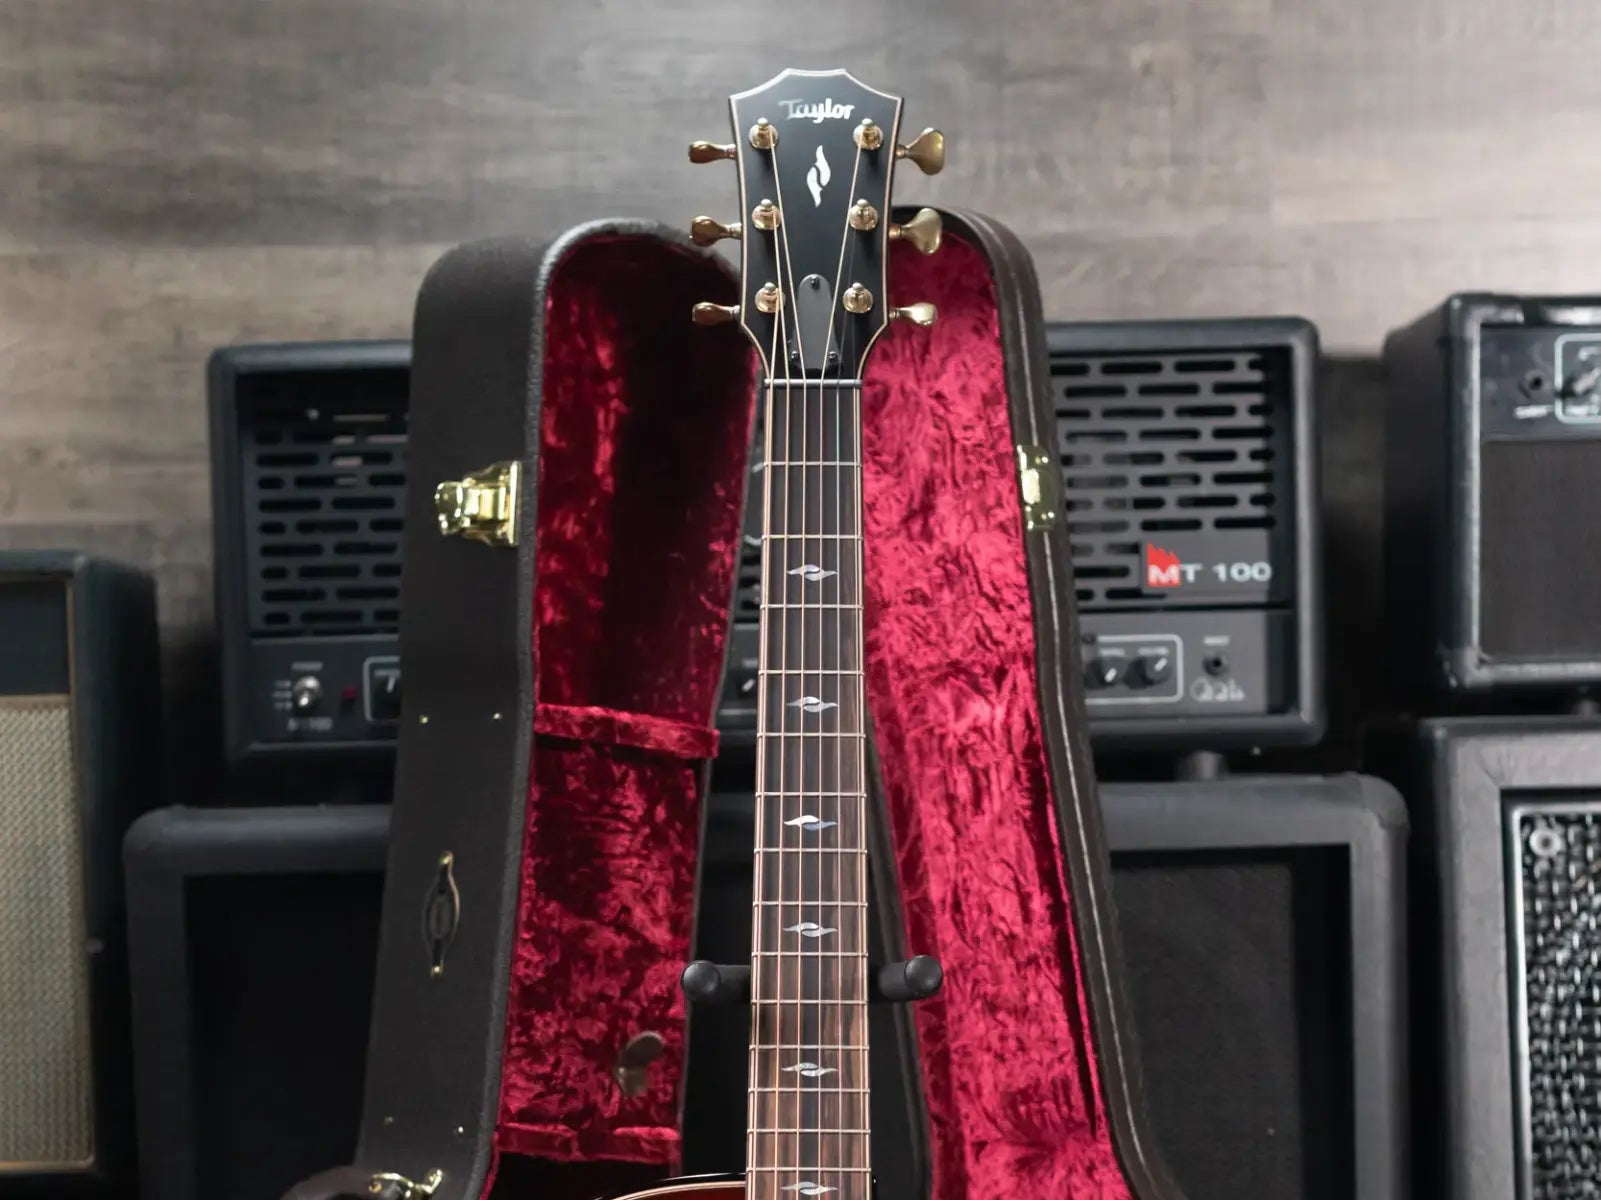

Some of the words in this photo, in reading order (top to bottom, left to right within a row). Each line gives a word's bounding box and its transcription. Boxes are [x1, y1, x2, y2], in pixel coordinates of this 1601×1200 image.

[778, 97, 855, 124] Taylor
[1147, 562, 1202, 585] MT
[1212, 562, 1273, 583] 100
